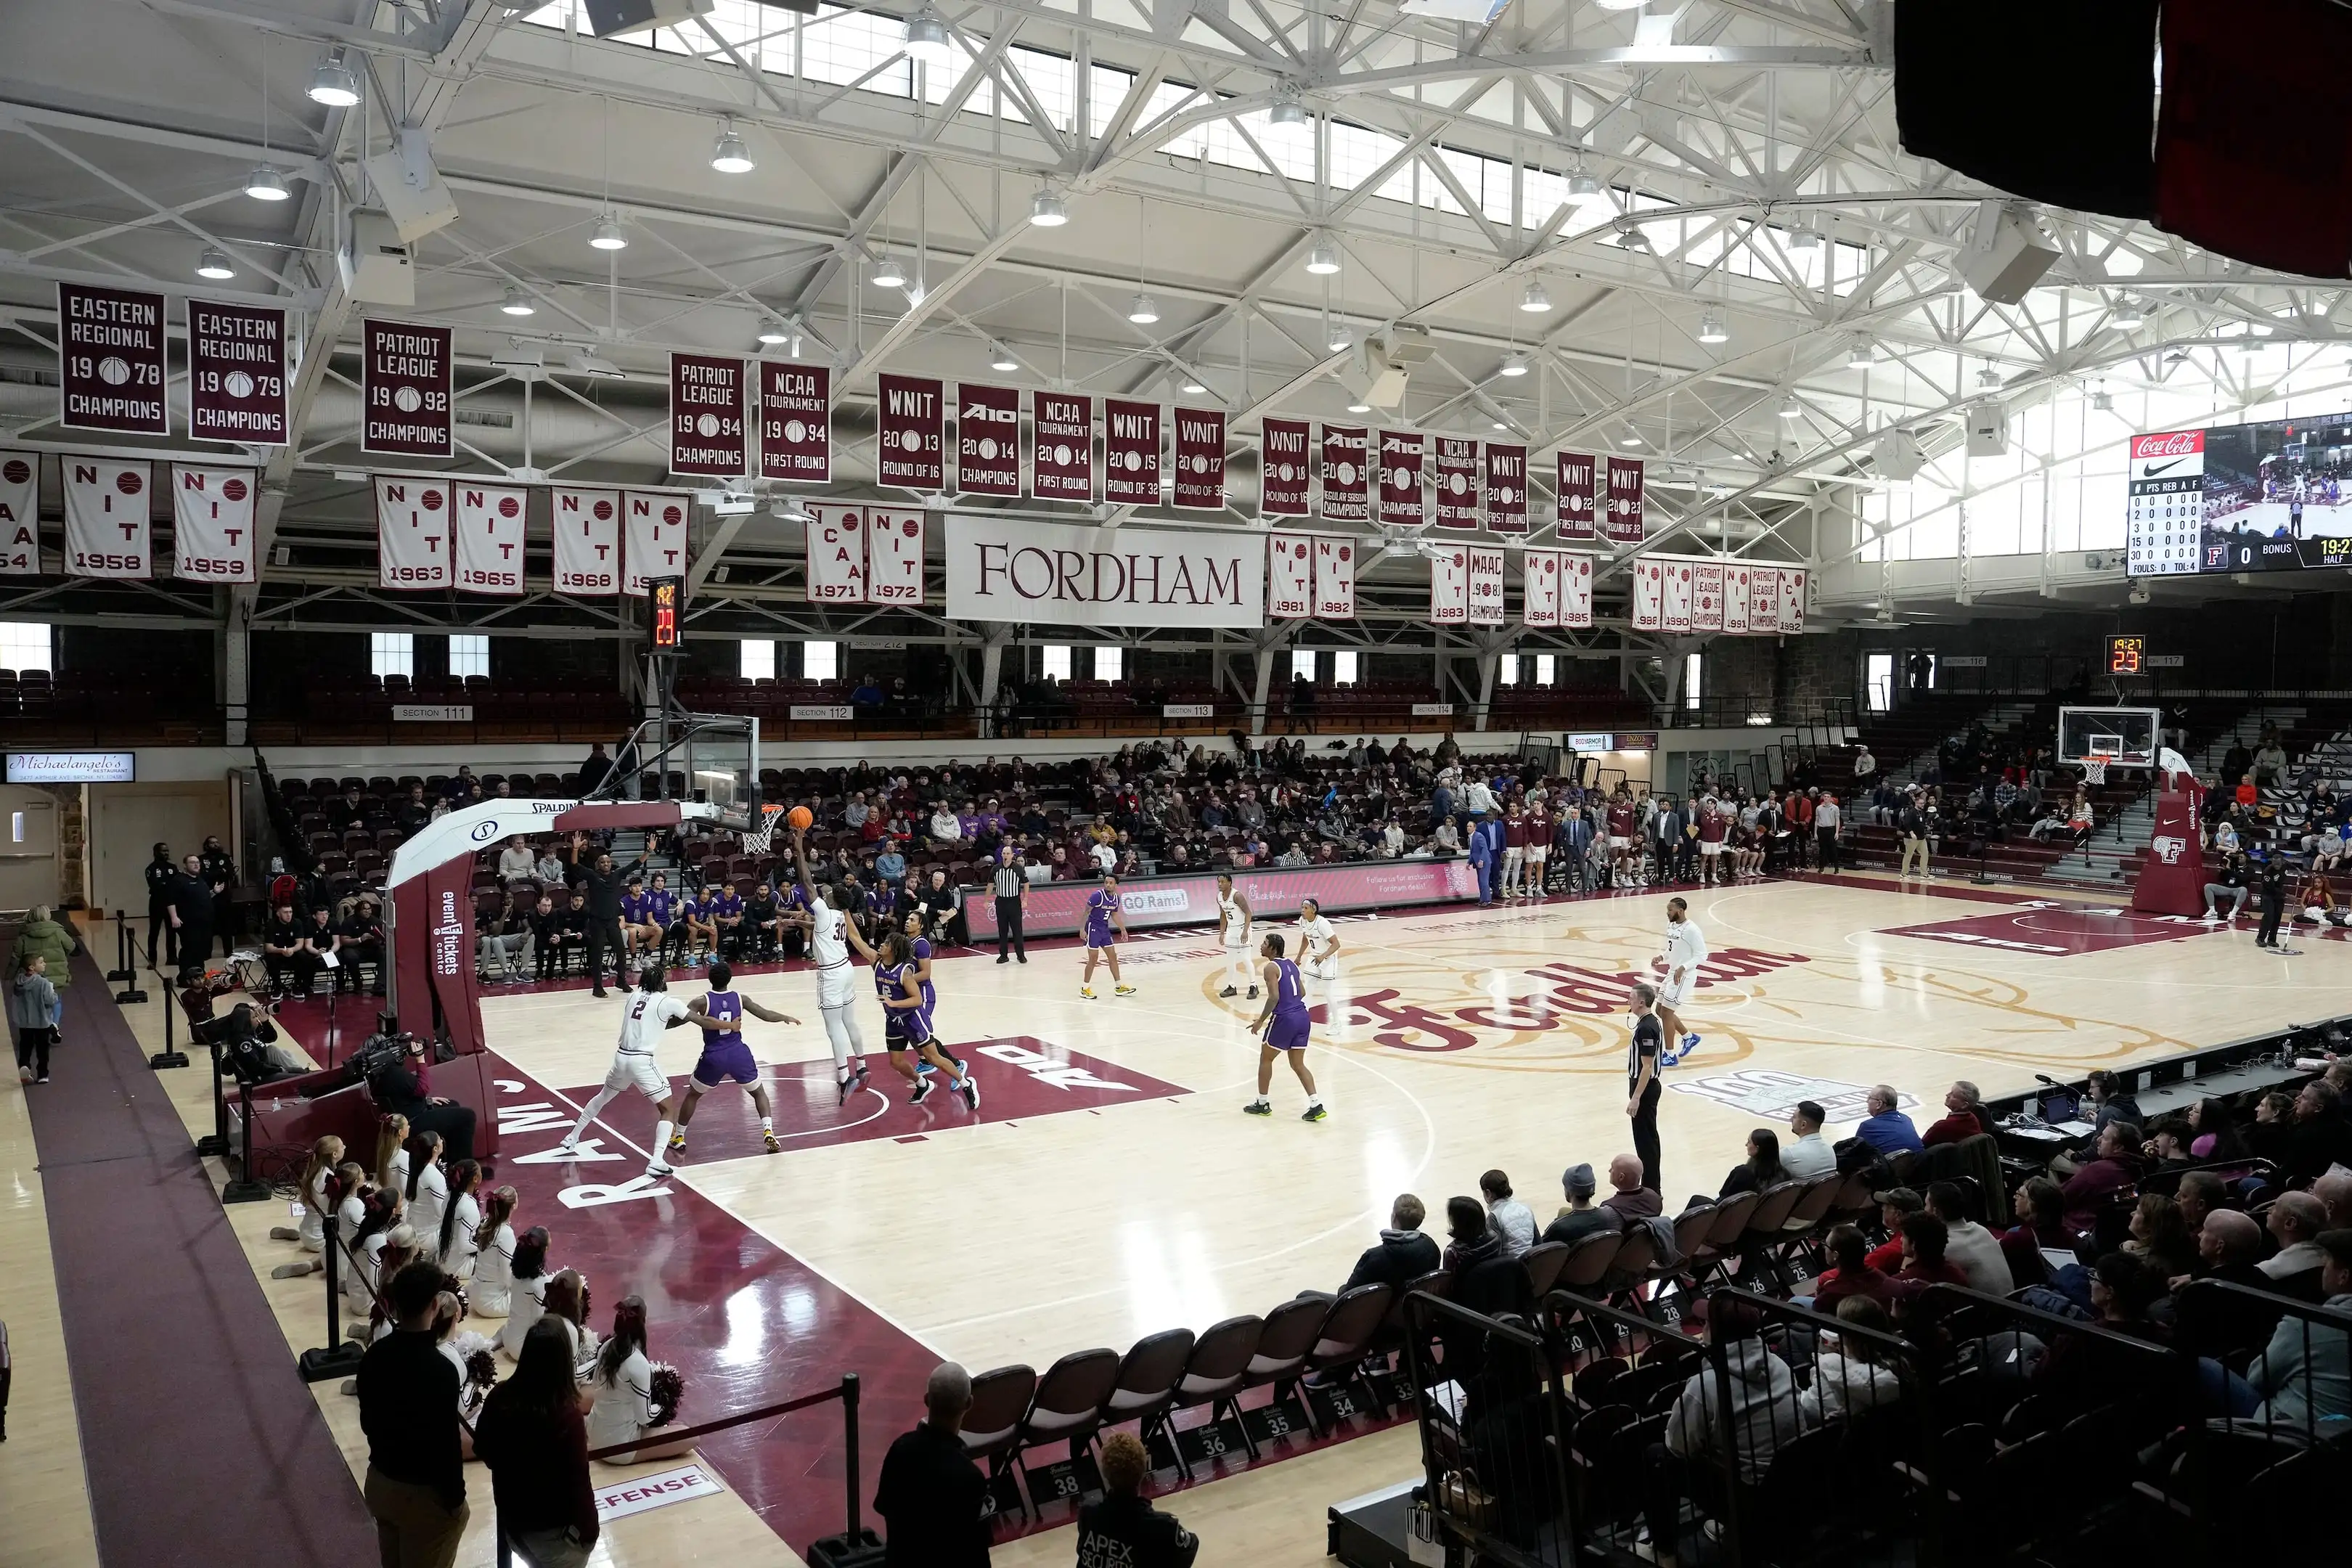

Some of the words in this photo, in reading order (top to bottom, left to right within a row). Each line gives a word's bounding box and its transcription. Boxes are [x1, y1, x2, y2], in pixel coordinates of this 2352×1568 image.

[70, 296, 155, 325] EASTERN
[199, 314, 276, 340] EASTERN
[71, 322, 155, 349] REGIONAL
[200, 338, 276, 363] REGIONAL
[377, 332, 440, 356] PATRIOT
[71, 356, 92, 378] 19
[134, 363, 160, 385] 78
[377, 354, 438, 377] LEAGUE
[682, 364, 735, 385] PATRIOT
[200, 371, 219, 392] 19
[258, 376, 280, 396] 79
[776, 373, 814, 396] NCAA
[372, 386, 389, 407] 19
[425, 391, 446, 412] 92
[682, 385, 733, 405] LEAGUE
[764, 394, 825, 412] TOURNAMENT
[70, 394, 160, 420] CHAMPIONS
[889, 389, 934, 418] WNIT
[1046, 401, 1079, 422] NCAA
[197, 408, 281, 430] CHAMPIONS
[678, 415, 693, 433] 19
[722, 418, 740, 436] 94
[1114, 413, 1152, 439] WNIT
[369, 422, 446, 444] CHAMPIONS
[767, 421, 781, 438] 19
[809, 424, 825, 441] 94
[1038, 421, 1088, 437] TOURNAMENT
[1182, 420, 1219, 444] WNIT
[883, 430, 899, 447] 20
[925, 434, 938, 451] 13
[963, 438, 976, 455] 20
[1002, 442, 1014, 459] 14
[1270, 430, 1304, 452] WNIT
[1445, 440, 1469, 457] NCAA
[677, 446, 741, 465] CHAMPIONS
[765, 453, 792, 467] FIRST
[795, 455, 825, 469] ROUND
[1038, 445, 1052, 462] 20
[1075, 449, 1087, 465] 14
[1110, 451, 1122, 467] 20
[1145, 454, 1156, 470] 15
[1179, 454, 1190, 470] 20
[1210, 458, 1222, 472] 17
[1437, 454, 1476, 468] TOURNAMENT
[883, 461, 913, 476] ROUND
[916, 464, 928, 477] OF
[930, 465, 939, 478] 16
[1265, 462, 1277, 478] 20
[1493, 455, 1521, 477] WNIT
[1563, 463, 1590, 485] WNIT
[962, 467, 1016, 486] CHAMPIONS
[1038, 475, 1061, 488] FIRST
[1063, 477, 1088, 490] ROUND
[1612, 468, 1638, 489] WNIT
[1108, 479, 1133, 494] ROUND
[1136, 482, 1146, 494] OF
[1177, 483, 1201, 495] ROUND
[2147, 483, 2160, 493] PTS
[2163, 482, 2177, 491] REB
[2181, 481, 2186, 490] A
[2192, 480, 2197, 489] F
[1266, 490, 1289, 502] ROUND
[1324, 490, 1347, 502] REGULAR
[1347, 493, 1366, 502] SEASON
[1488, 488, 1499, 501] 20
[1514, 489, 1524, 502] 21
[1324, 501, 1367, 516] CHAMPIONS
[1381, 502, 1421, 515] CHAMPIONS
[1437, 504, 1455, 518] FIRST
[1457, 507, 1477, 518] ROUND
[2135, 510, 2140, 520] 2
[1488, 511, 1504, 523] FIRST
[1508, 513, 1525, 524] ROUND
[1559, 519, 1574, 530] FIRST
[1575, 520, 1593, 531] ROUND
[1607, 522, 1625, 532] ROUND
[2134, 523, 2139, 533] 3
[2132, 537, 2141, 547] 15
[76, 552, 141, 570] 1958
[2131, 550, 2141, 560] 30
[2241, 547, 2250, 564] 0
[2263, 544, 2292, 554] BONUS
[2324, 555, 2343, 563] HALF
[184, 557, 244, 574] 1959
[1472, 555, 1501, 575] MAAC
[1696, 567, 1720, 579] PATRIOT
[2133, 564, 2157, 573] FOULS:
[2161, 563, 2165, 572] 0
[2174, 563, 2189, 571] TOL:
[2190, 562, 2195, 571] 4
[391, 567, 442, 581] 1963
[464, 570, 515, 586] 1965
[562, 573, 611, 587] 1968
[974, 542, 1243, 605] FORDHAM
[1753, 571, 1776, 581] PATRIOT
[815, 584, 856, 597] 1971
[876, 584, 916, 597] 1972
[1696, 581, 1720, 593] LEAGUE
[1753, 585, 1774, 595] LEAGUE
[1276, 600, 1304, 611] 1981
[1321, 602, 1349, 613] 1982
[1436, 608, 1463, 617] 1983
[1471, 605, 1503, 619] CHAMPIONS
[1529, 611, 1554, 621] 1984
[1564, 612, 1588, 622] 1985
[1666, 616, 1689, 626] 1990
[1694, 612, 1721, 626] CHAMPIONS
[1752, 615, 1776, 627] CHAMPIONS
[657, 609, 674, 644] 23
[1780, 621, 1801, 631] 1992
[2115, 639, 2141, 650] 19:27
[2113, 651, 2139, 671] 23
[444, 707, 464, 719] 111
[830, 707, 847, 718] 112
[1195, 706, 1208, 716] 113
[1438, 705, 1449, 714] 114
[9, 756, 121, 772] Michaelangelo's
[443, 891, 457, 923] event
[1124, 897, 1145, 909] GO
[1148, 893, 1187, 907] Rams!
[1103, 910, 1111, 920] 3
[833, 923, 846, 941] 30
[444, 936, 459, 975] tickets
[1291, 974, 1297, 996] 1
[632, 1001, 647, 1020] 2
[1793, 1268, 1808, 1281] 25
[1750, 1280, 1765, 1293] 26
[1663, 1307, 1680, 1320] 28
[1395, 1383, 1415, 1397] 33
[1334, 1402, 1354, 1417] 34
[1267, 1418, 1289, 1435] 35
[1203, 1437, 1226, 1455] 36
[1055, 1477, 1079, 1495] 38
[1084, 1530, 1132, 1563] APEX
